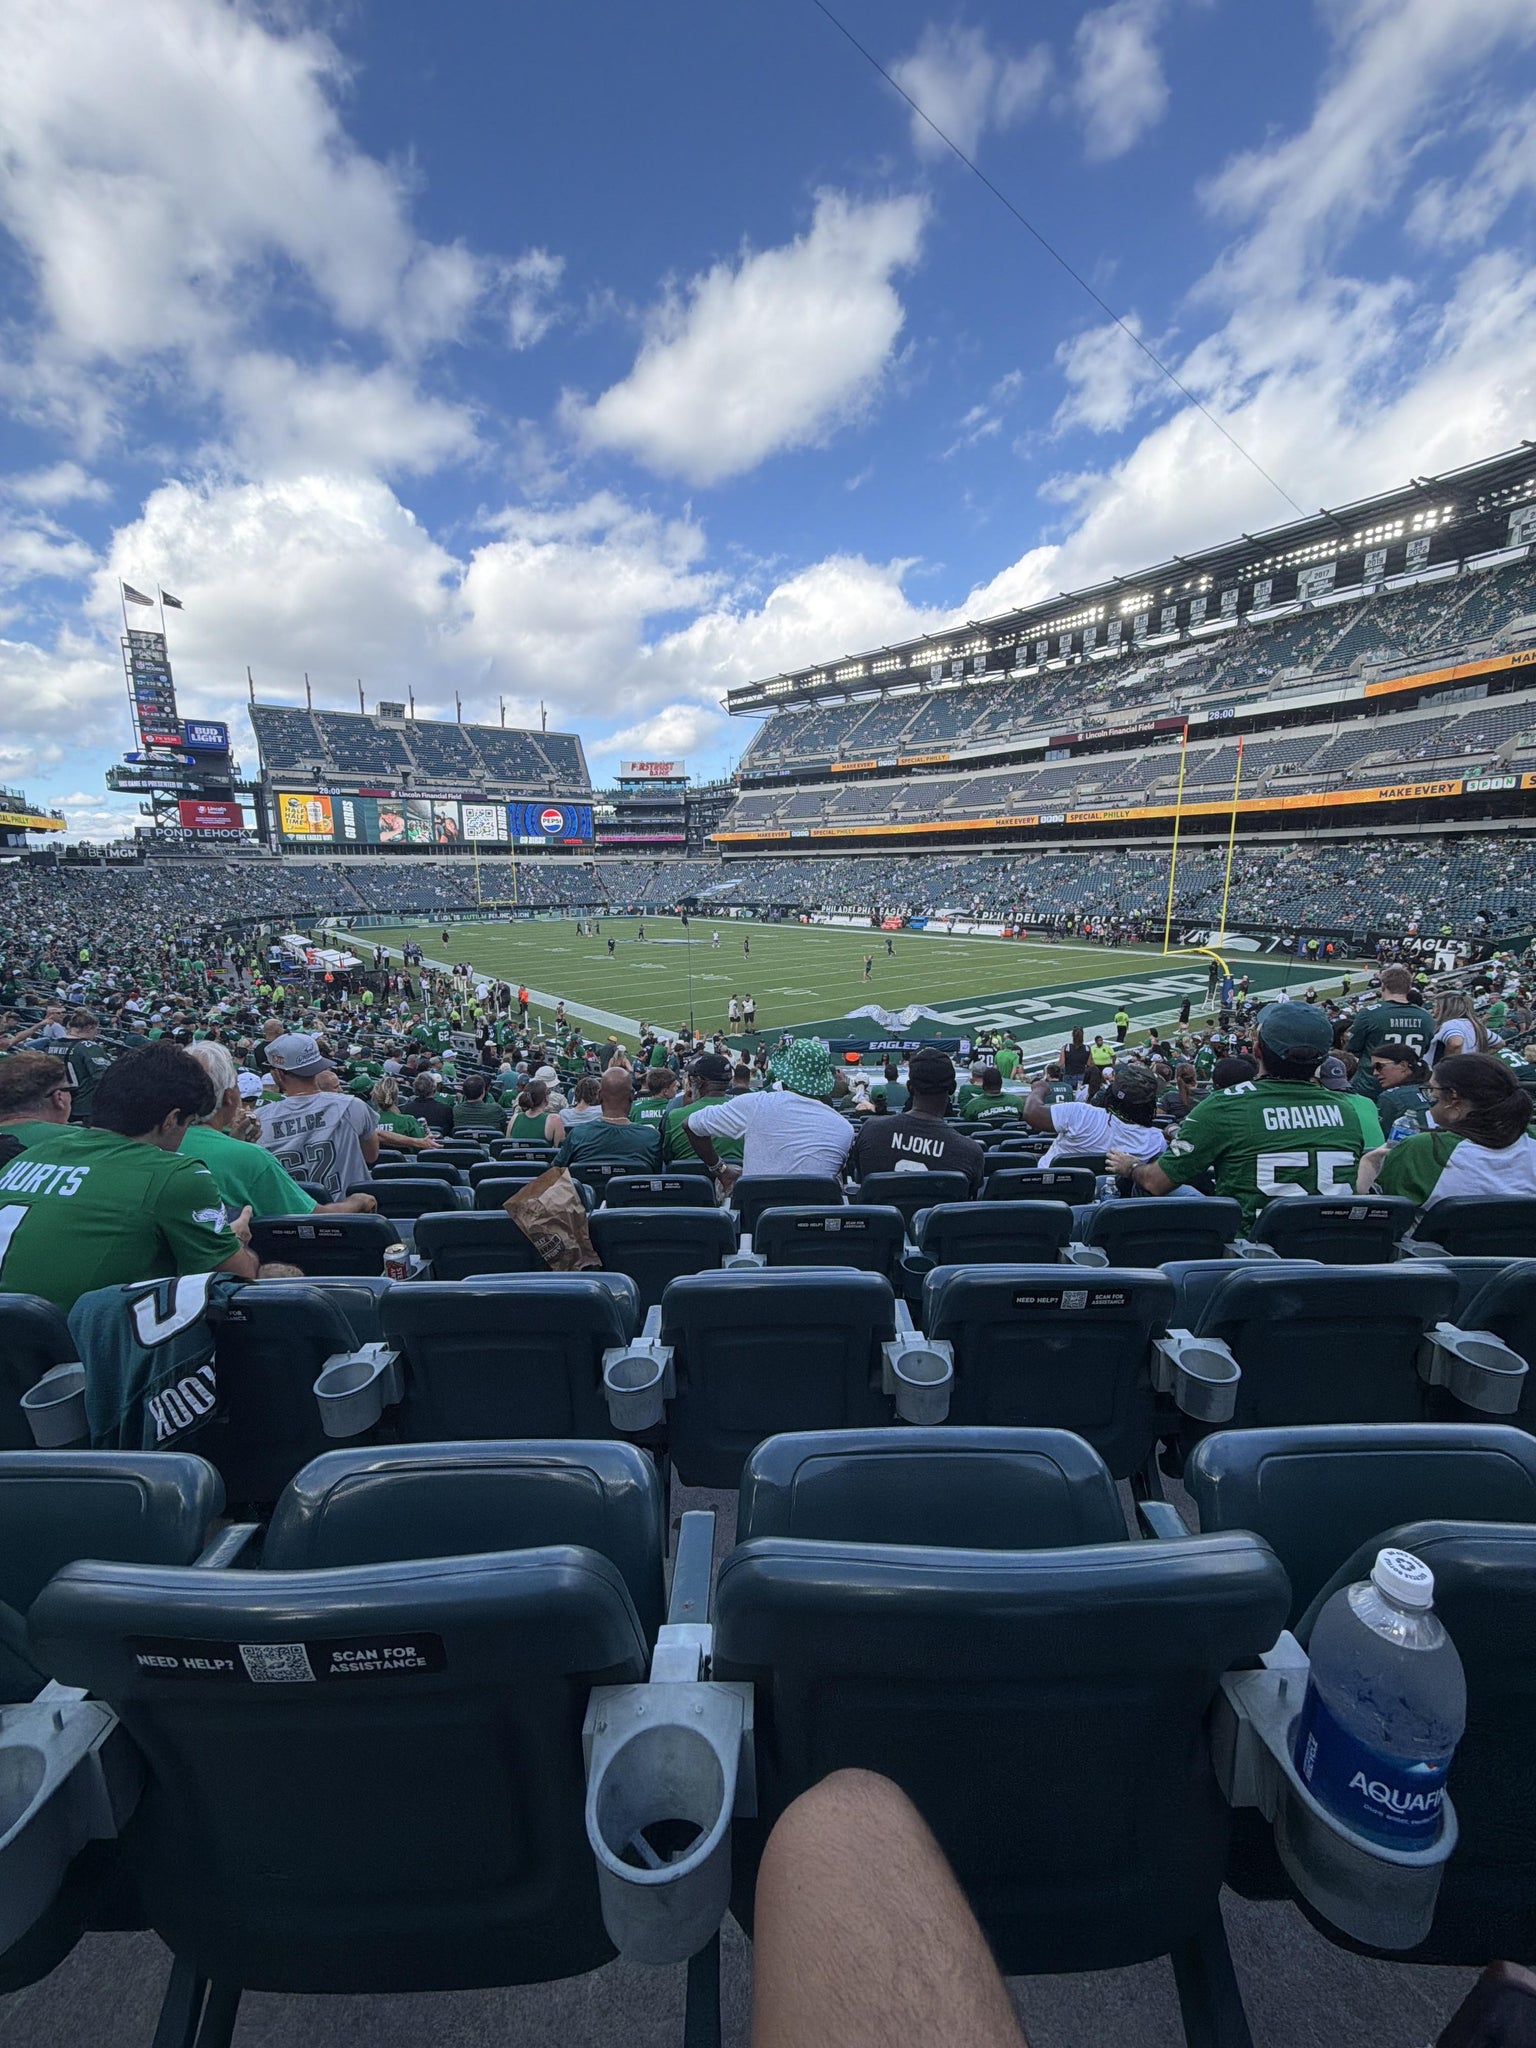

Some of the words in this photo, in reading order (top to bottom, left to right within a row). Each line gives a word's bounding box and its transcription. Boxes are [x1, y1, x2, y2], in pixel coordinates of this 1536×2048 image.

[1408, 546, 1428, 556] 2022
[1314, 570, 1330, 580] 2017
[1209, 708, 1234, 719] 28:00
[192, 732, 223, 742] LIGHT
[194, 726, 218, 735] BUD
[1086, 730, 1108, 740] Lincoln
[1108, 726, 1138, 736] Financial
[1138, 722, 1154, 732] Field
[1379, 786, 1412, 798] MAKE
[1414, 783, 1456, 796] EVERY
[1468, 778, 1513, 790] SPIN
[342, 800, 355, 826] BIRDS
[156, 828, 192, 837] POND
[197, 828, 254, 838] LEHOCKY
[345, 826, 356, 839] GO
[821, 905, 875, 914] PHILADELPHIA
[879, 908, 912, 916] EAGLES
[1390, 1018, 1422, 1028] BARKLEY
[438, 1030, 449, 1041] 62
[869, 1041, 920, 1050] EAGLES
[978, 1106, 1018, 1119] PHILADELPHIA
[1263, 1105, 1344, 1130] GRAHAM
[272, 1112, 326, 1139] KELCE
[891, 1132, 945, 1158] NJOKU
[271, 1140, 342, 1195] 62
[1256, 1152, 1356, 1196] 55
[0, 1162, 90, 1195] HURTS
[332, 1649, 377, 1662] SCAN
[383, 1647, 417, 1658] FOR
[136, 1654, 178, 1668] NEED
[185, 1658, 234, 1670] HELP?
[329, 1657, 427, 1673] ASSISTANCE
